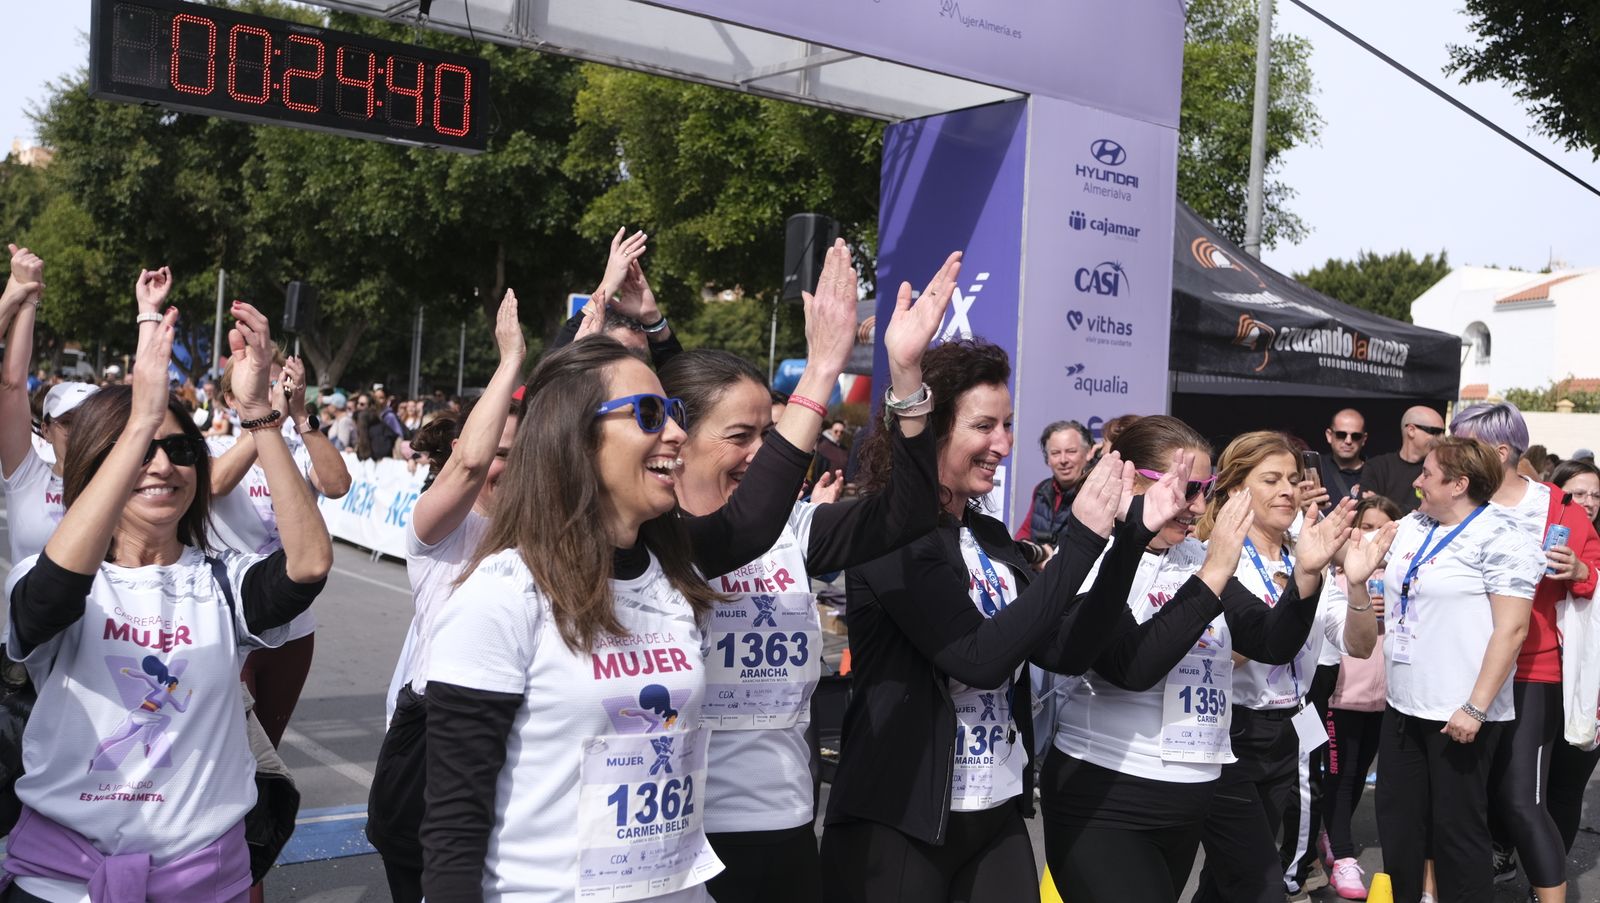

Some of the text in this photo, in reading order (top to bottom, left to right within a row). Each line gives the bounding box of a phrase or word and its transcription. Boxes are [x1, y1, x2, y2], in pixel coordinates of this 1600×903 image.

[170, 12, 472, 137] 00:24:40
[1075, 164, 1139, 188] HYUNDAI
[1083, 182, 1132, 202] Almerialva
[1090, 218, 1141, 238] cajamar
[1074, 266, 1120, 297] CASI
[1087, 316, 1133, 336] vithas
[1074, 376, 1128, 396] aqualia
[385, 491, 418, 528] NE
[715, 610, 747, 618] MUJER
[103, 618, 193, 653] MUJER
[594, 632, 676, 649] CARRERA DE LA
[717, 632, 808, 668] 1363
[592, 647, 693, 680] MUJER
[740, 668, 788, 679] ARANCHA
[1179, 668, 1200, 676] MUJER
[955, 706, 977, 714] UJER
[1179, 686, 1226, 717] 1359
[1197, 715, 1218, 724] CARMEN
[956, 725, 1004, 756] 136
[1327, 721, 1337, 748] STELLA
[607, 756, 644, 767] MUJER
[955, 756, 994, 765] MARIA DE
[1329, 749, 1339, 775] MARIS
[80, 792, 93, 802] ES
[607, 775, 694, 827] 1362
[617, 824, 663, 839] CARMEN
[665, 820, 690, 833] BELEN
